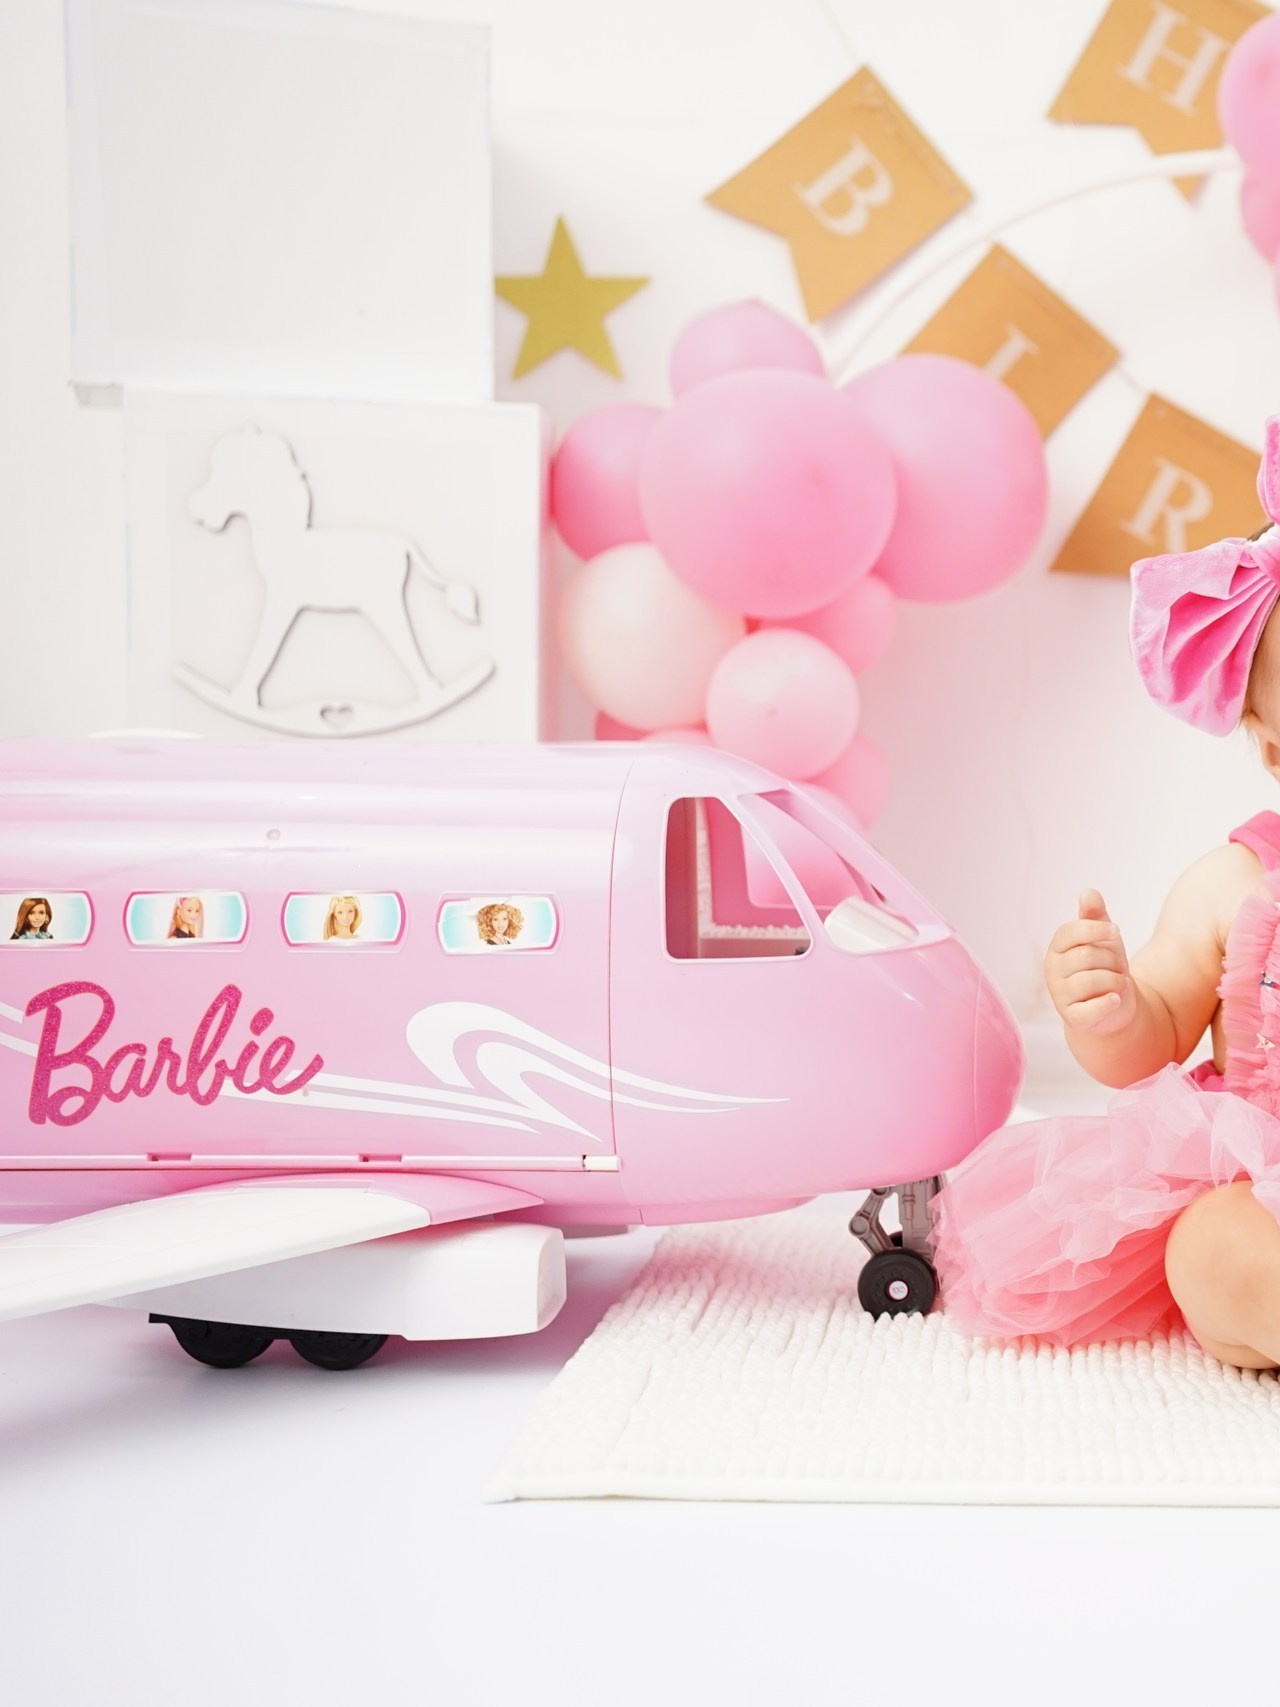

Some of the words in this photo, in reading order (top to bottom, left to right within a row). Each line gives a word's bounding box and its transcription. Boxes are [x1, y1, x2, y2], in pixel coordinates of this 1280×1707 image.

[1114, 0, 1232, 117] H
[793, 133, 894, 237] B
[1117, 456, 1214, 554] R
[25, 980, 324, 1127] Barbie
